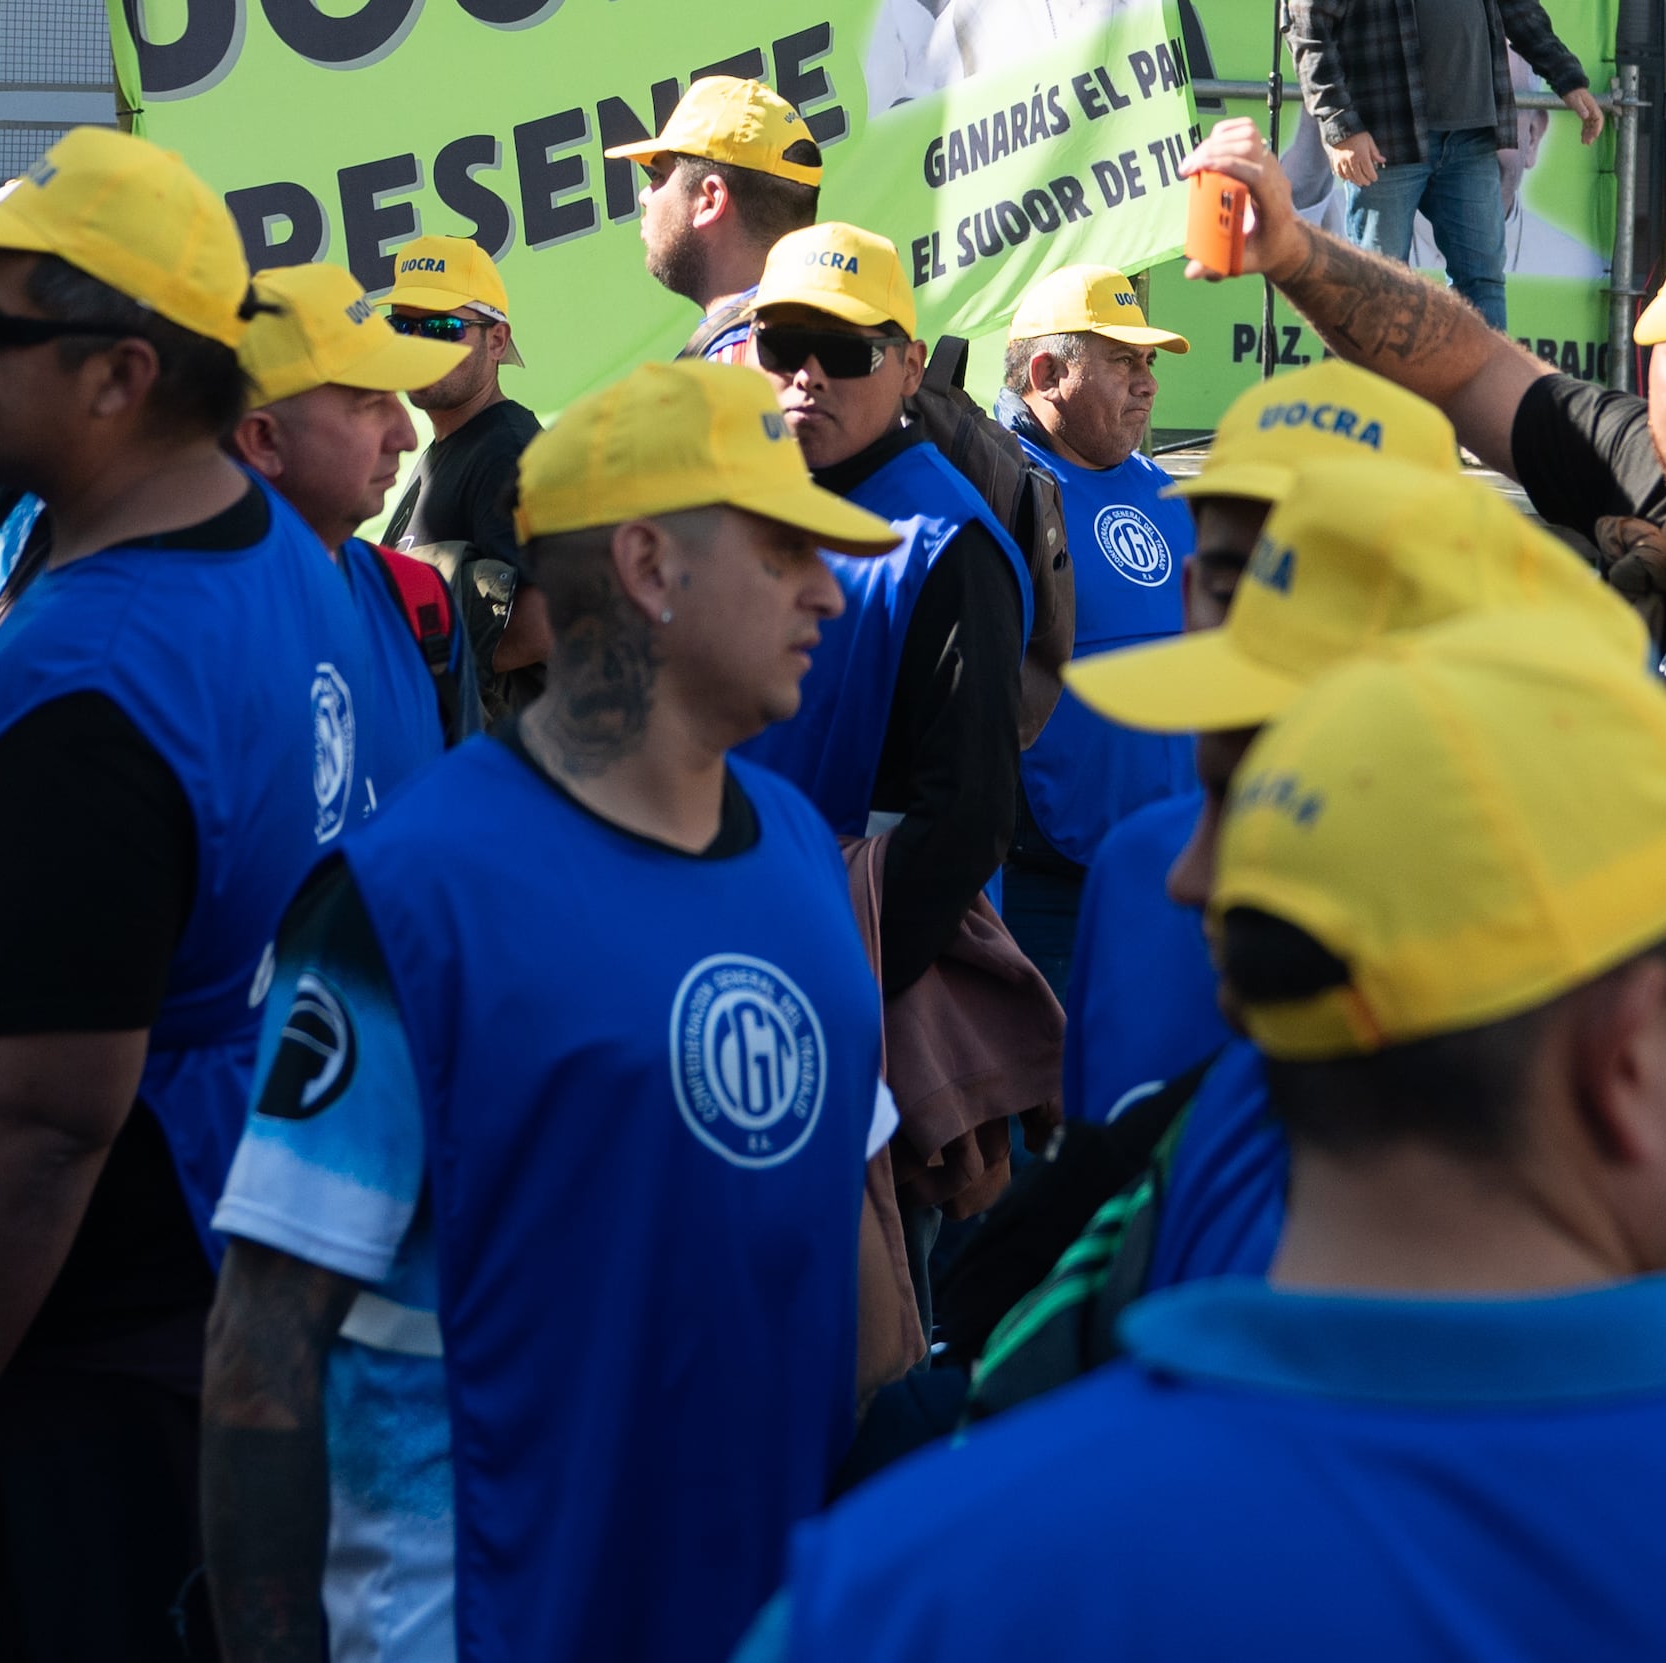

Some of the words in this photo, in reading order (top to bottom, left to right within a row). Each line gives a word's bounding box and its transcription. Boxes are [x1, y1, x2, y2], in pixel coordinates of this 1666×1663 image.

[923, 83, 1071, 189] GANARÁS
[1071, 65, 1132, 121] EL
[1127, 36, 1189, 100] PAN
[911, 230, 947, 289] EL
[956, 175, 1094, 269] SUDOR
[1090, 149, 1147, 209] DE
[1147, 132, 1191, 188] TU
[400, 257, 446, 274] UOCRA
[1257, 398, 1383, 453] UOCRA
